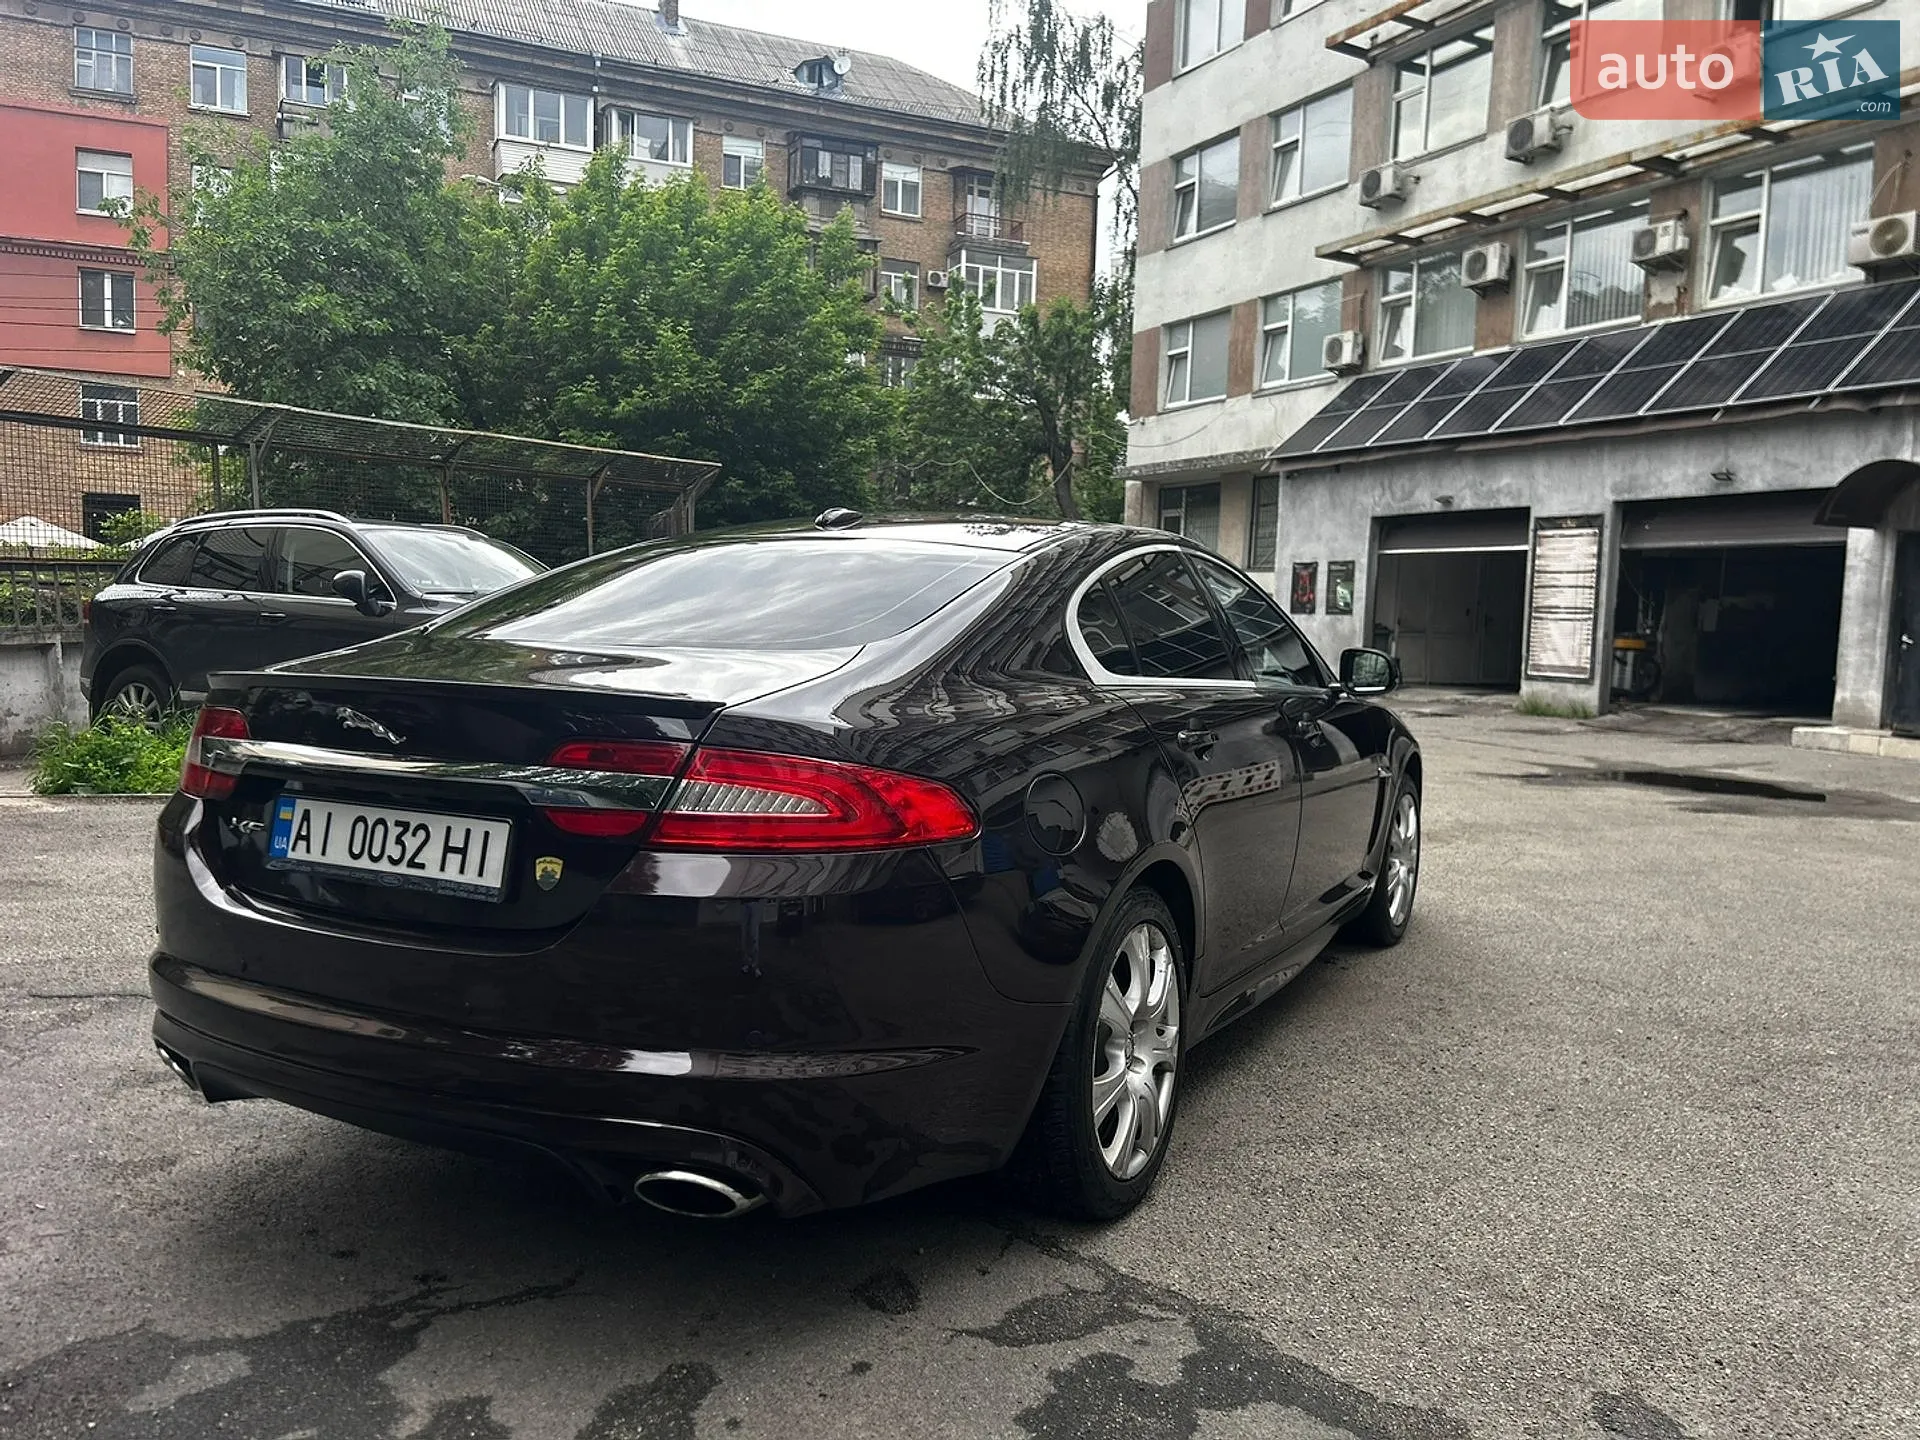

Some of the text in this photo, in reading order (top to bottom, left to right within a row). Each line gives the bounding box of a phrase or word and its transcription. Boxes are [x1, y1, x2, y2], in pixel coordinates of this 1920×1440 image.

[274, 836, 288, 849] UA
[291, 808, 332, 856] AI
[348, 815, 431, 870] 0032
[439, 825, 490, 878] HI
